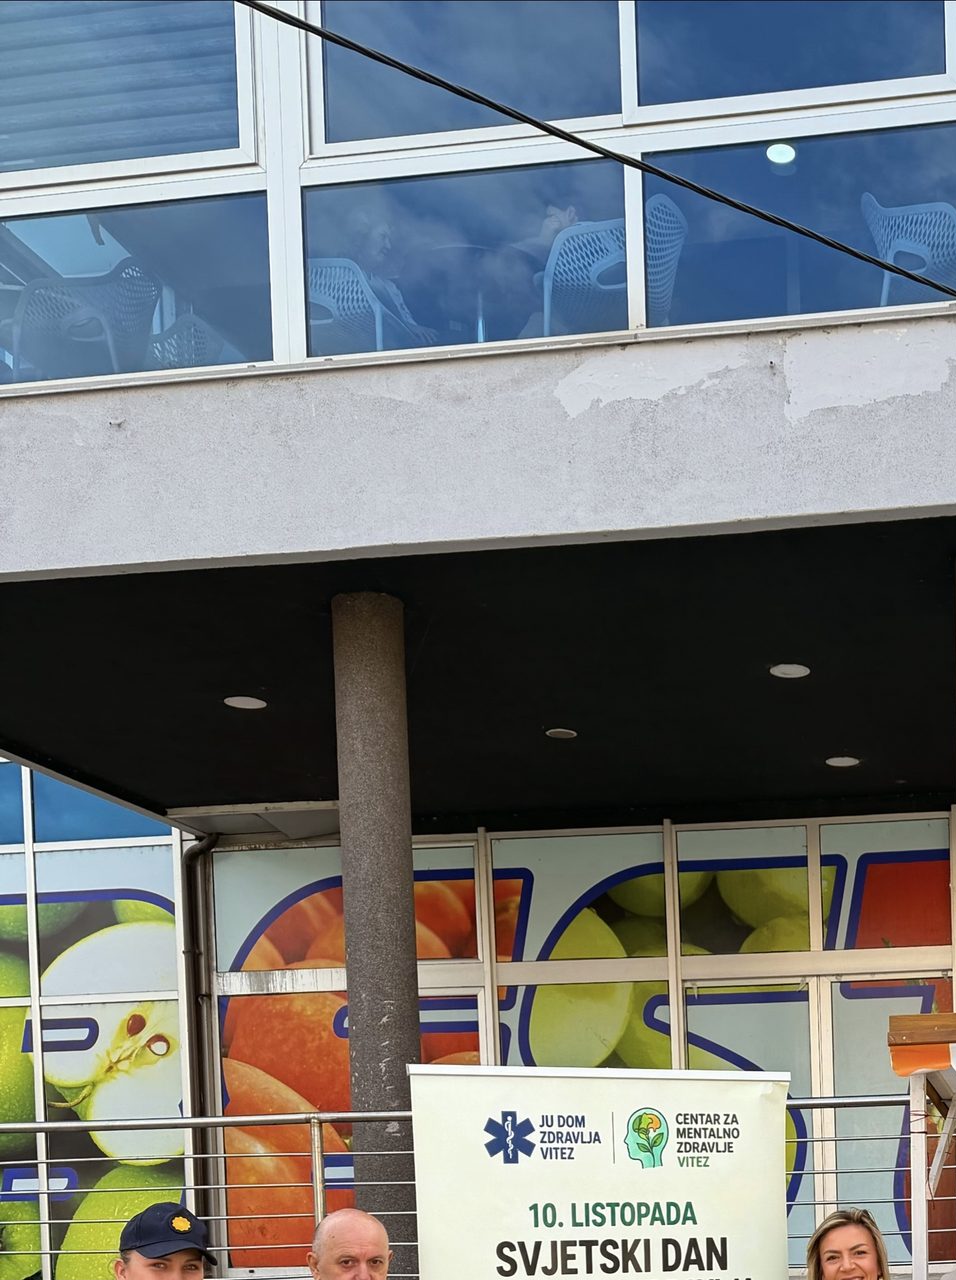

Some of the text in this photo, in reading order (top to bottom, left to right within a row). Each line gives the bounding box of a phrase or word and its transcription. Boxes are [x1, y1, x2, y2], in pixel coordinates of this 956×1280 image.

[539, 1114, 586, 1128] JU DOM
[675, 1113, 739, 1126] CENTAR ZA
[539, 1131, 601, 1145] ZDRAVLJA
[676, 1127, 740, 1140] MENTALNO
[540, 1147, 575, 1160] VITEZ
[676, 1141, 734, 1154] ZDRAVLJE
[677, 1155, 710, 1168] VITEZ
[529, 1201, 698, 1228] 10. LISTOPADA
[496, 1237, 728, 1277] SVJETSKI DAN
